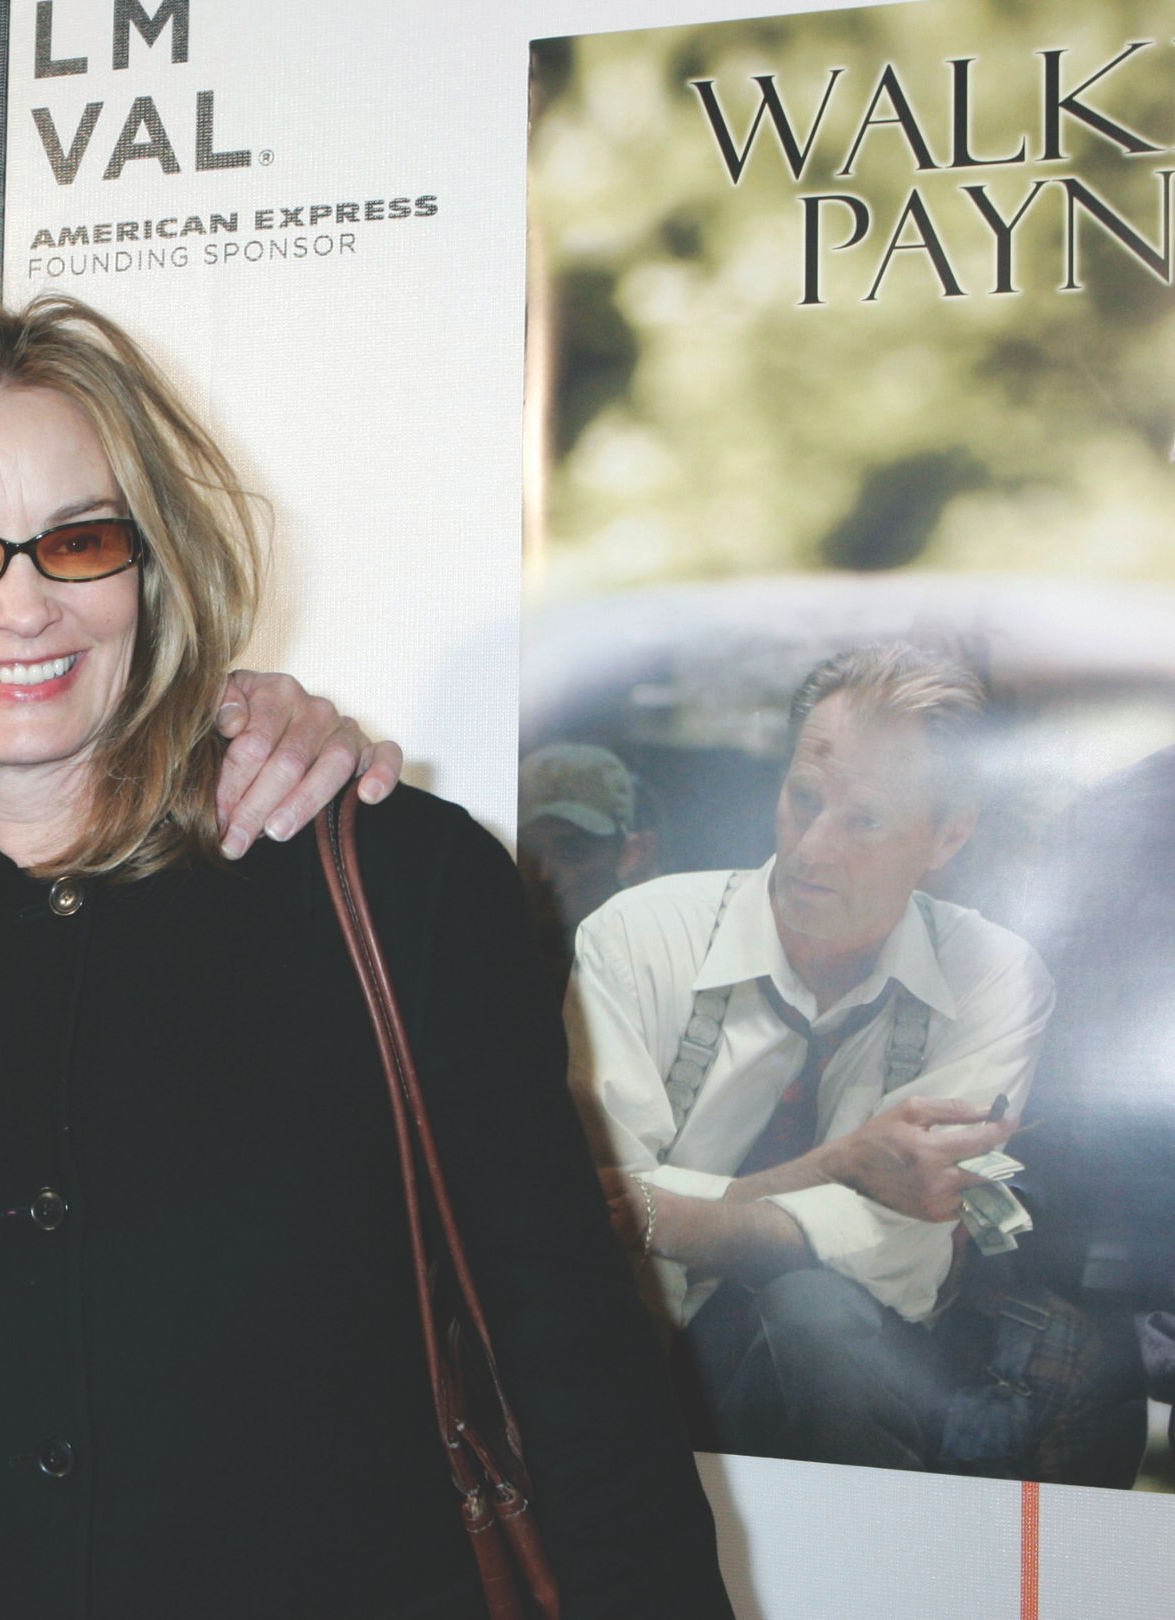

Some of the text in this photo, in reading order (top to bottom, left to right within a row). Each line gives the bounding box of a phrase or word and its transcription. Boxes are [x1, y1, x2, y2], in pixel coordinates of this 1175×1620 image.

[29, 195, 439, 250] AMERICAN EXPRESS
[27, 232, 357, 280] FOUNDING SPONSOR
